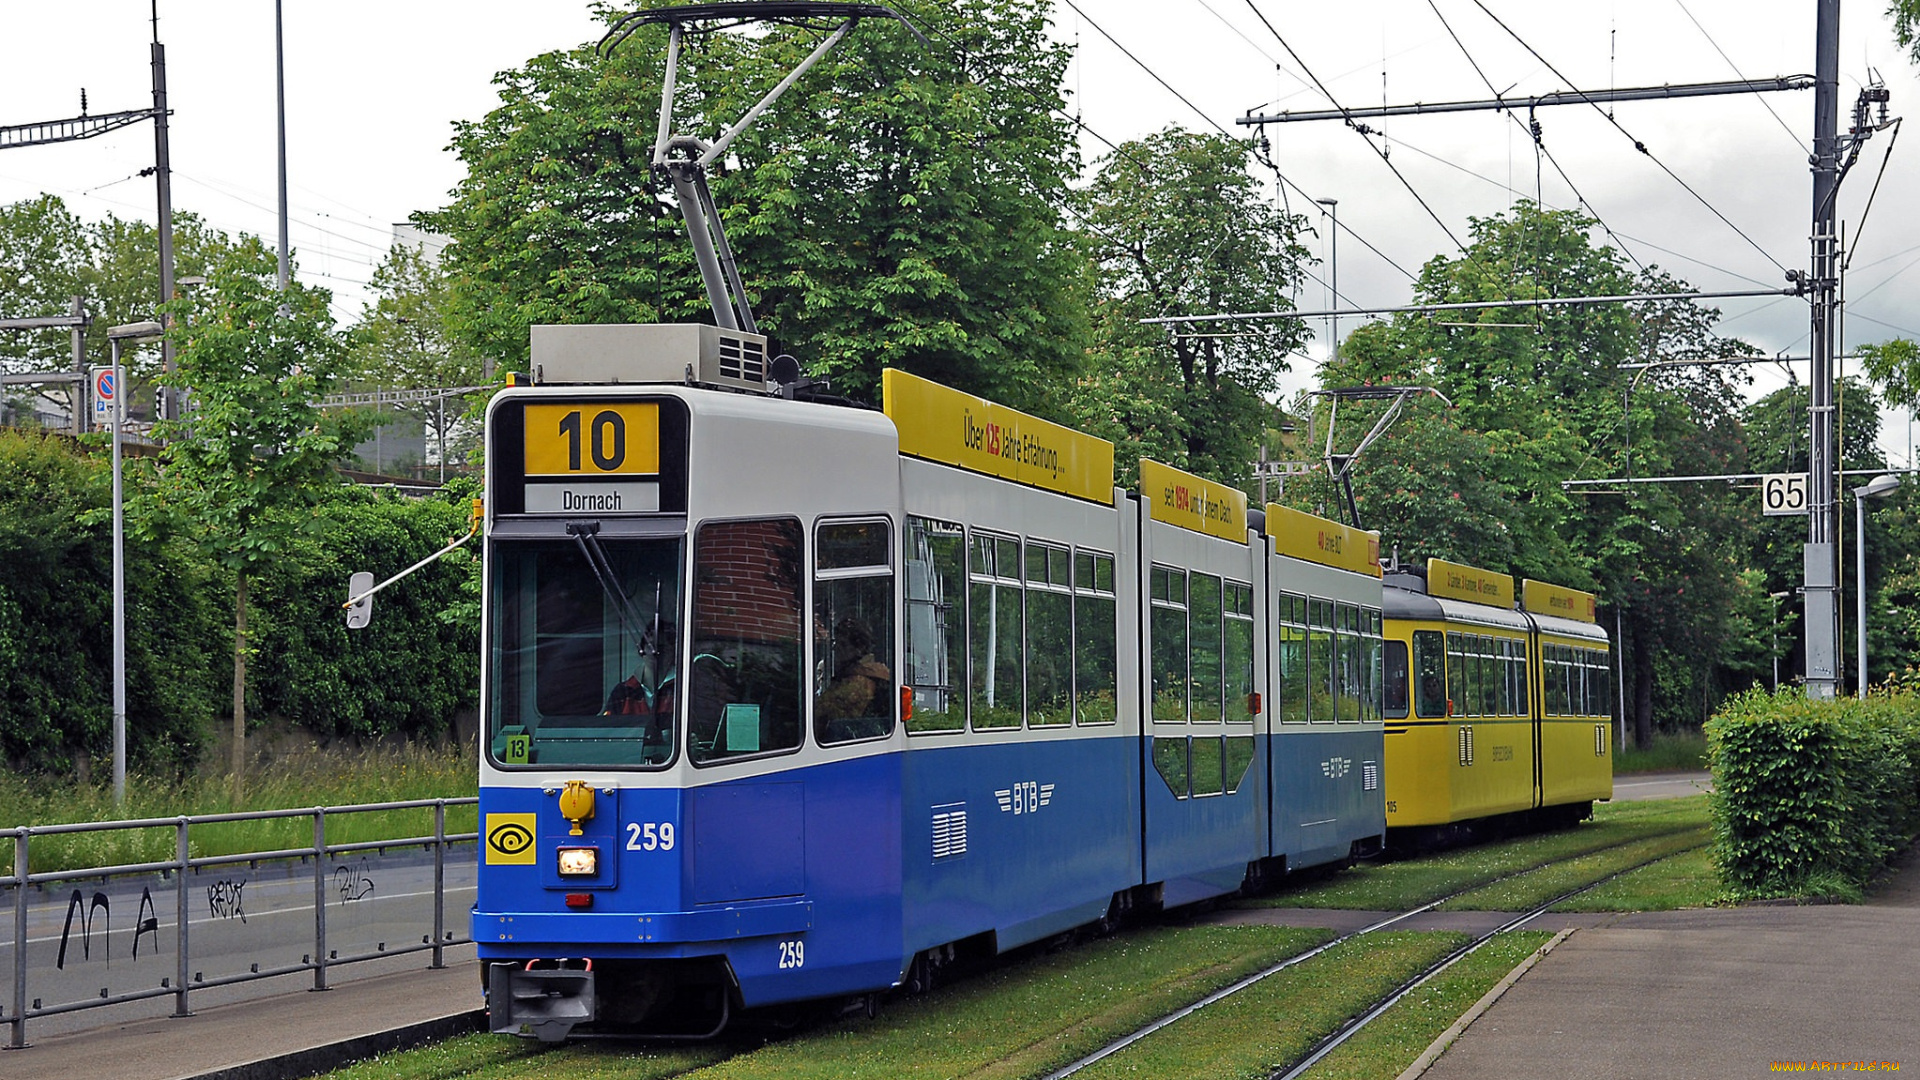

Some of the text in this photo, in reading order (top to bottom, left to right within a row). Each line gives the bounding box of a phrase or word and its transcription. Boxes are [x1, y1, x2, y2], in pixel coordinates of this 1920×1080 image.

[558, 409, 626, 472] 10
[964, 408, 984, 451] Über
[986, 422, 1000, 456] 125
[1001, 427, 1021, 462] Jahre
[563, 490, 622, 511] Dornach
[1164, 482, 1175, 508] seit
[1175, 485, 1189, 511] 1974
[1766, 478, 1804, 509] 65
[510, 739, 526, 759] 13
[1330, 757, 1343, 779] BTB
[1013, 781, 1039, 815] BTB
[1386, 801, 1397, 813] 105
[625, 822, 676, 852] 259
[778, 940, 805, 970] 259
